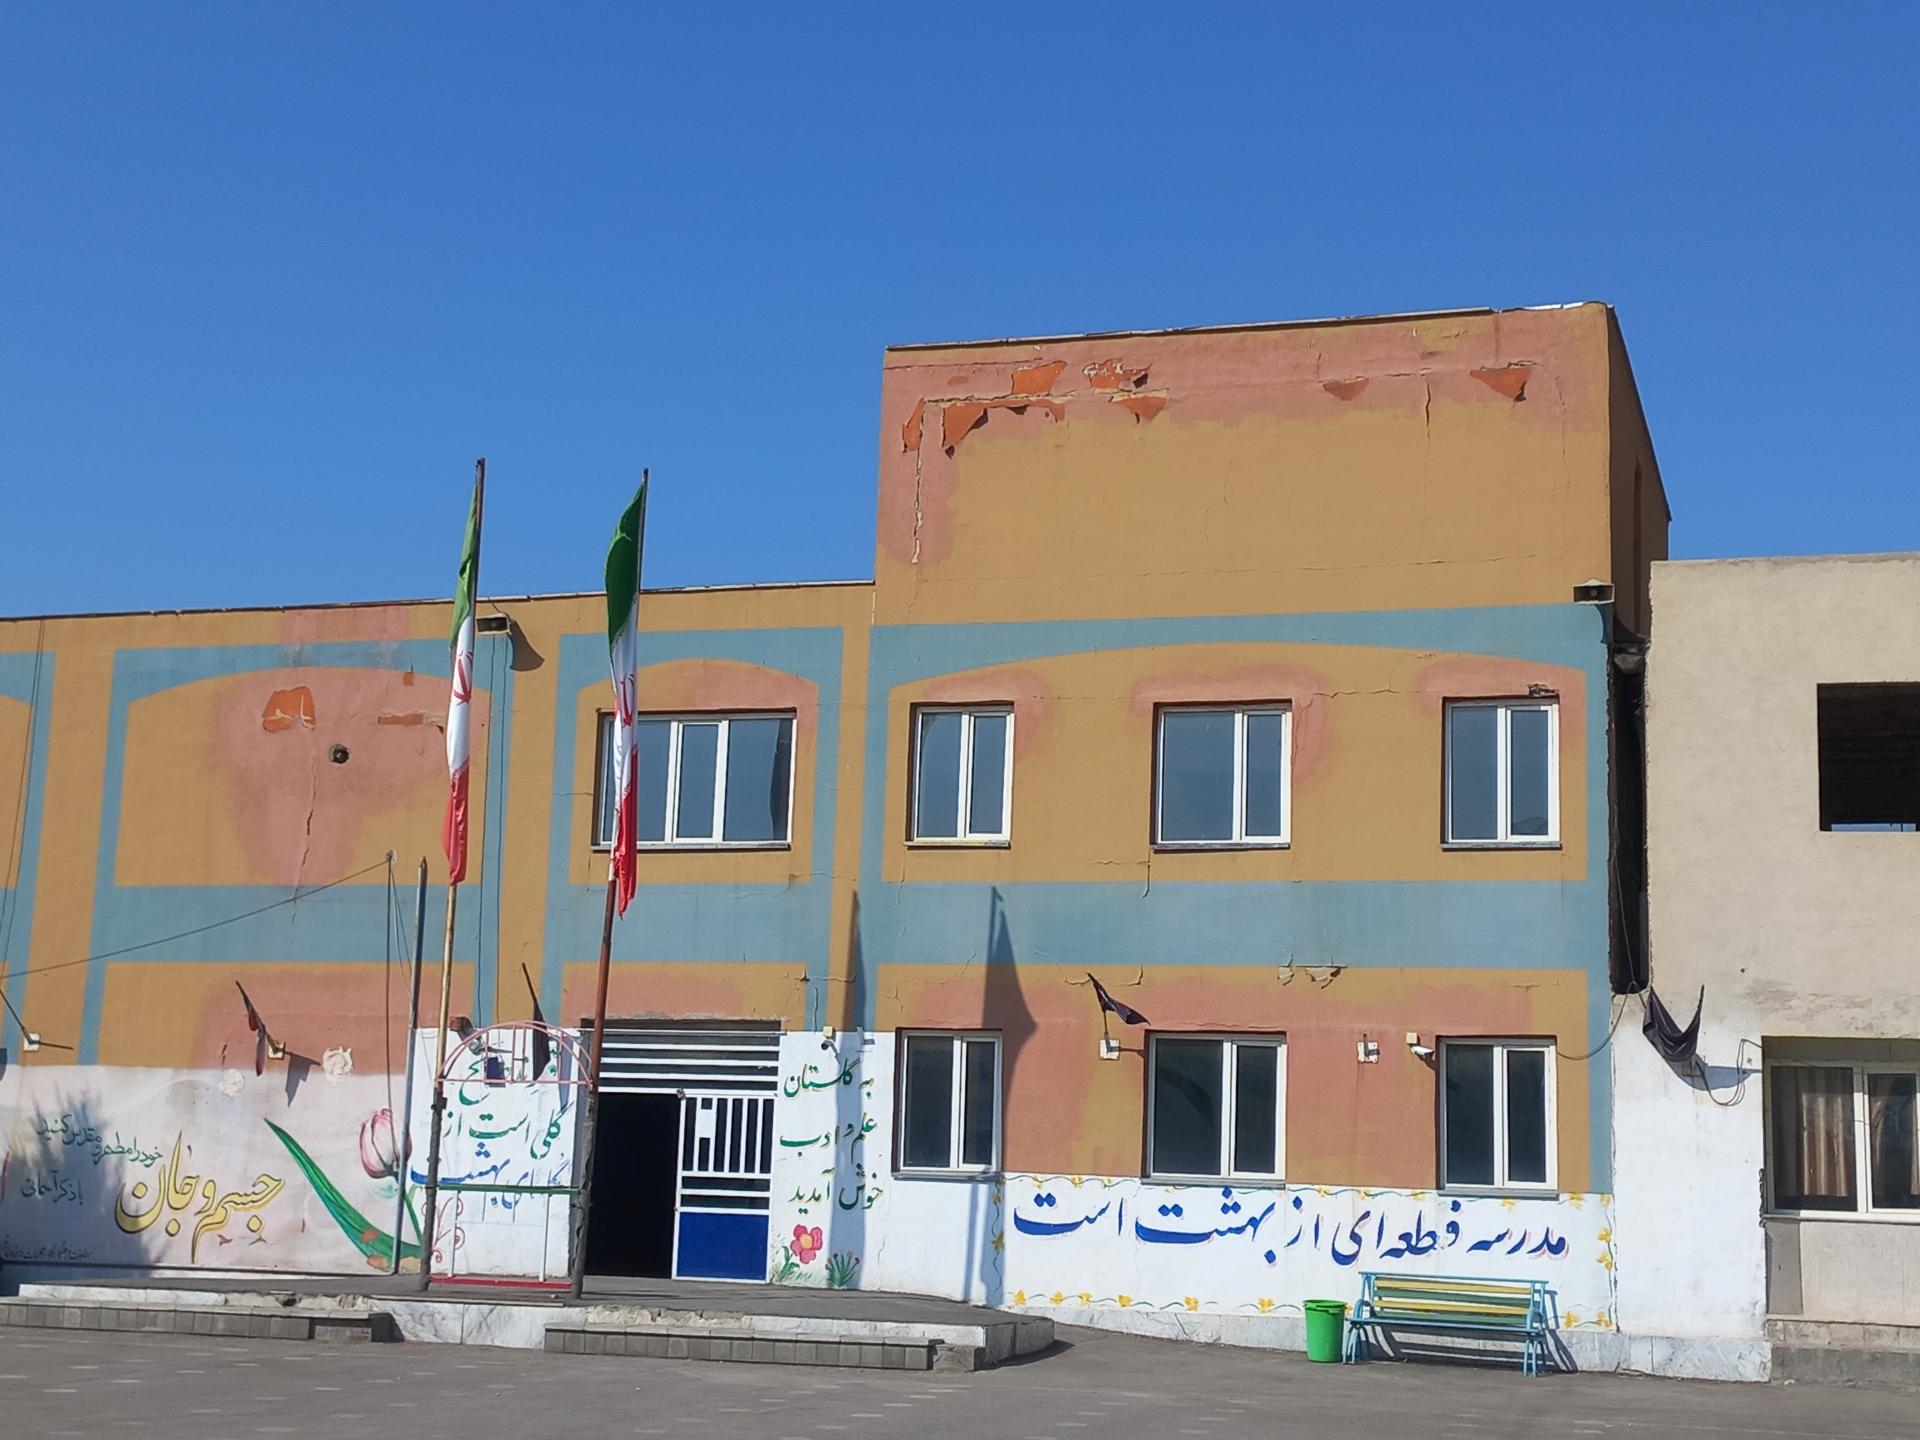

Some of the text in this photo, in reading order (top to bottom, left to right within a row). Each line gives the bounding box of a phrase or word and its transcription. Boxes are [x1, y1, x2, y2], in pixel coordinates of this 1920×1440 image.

[784, 1057, 875, 1099] به گلستان
[37, 1114, 72, 1141] کنید
[62, 1127, 103, 1147] مقدس
[93, 1131, 133, 1165] مطهر
[443, 1101, 575, 1160] گلی است از
[780, 1113, 877, 1164] علم و ادب
[137, 1146, 163, 1168] خود
[411, 1142, 511, 1206] بهشت
[21, 1169, 60, 1198] آسمانی
[53, 1178, 78, 1204] ذکر
[114, 1130, 286, 1264] جسم و جان
[789, 1162, 884, 1215] خوش آمدید
[1012, 1191, 1125, 1236] است
[1135, 1187, 1277, 1266] بهشت
[1284, 1196, 1321, 1249] از
[1330, 1210, 1384, 1266] ای
[1466, 1225, 1568, 1256] مدرسه
